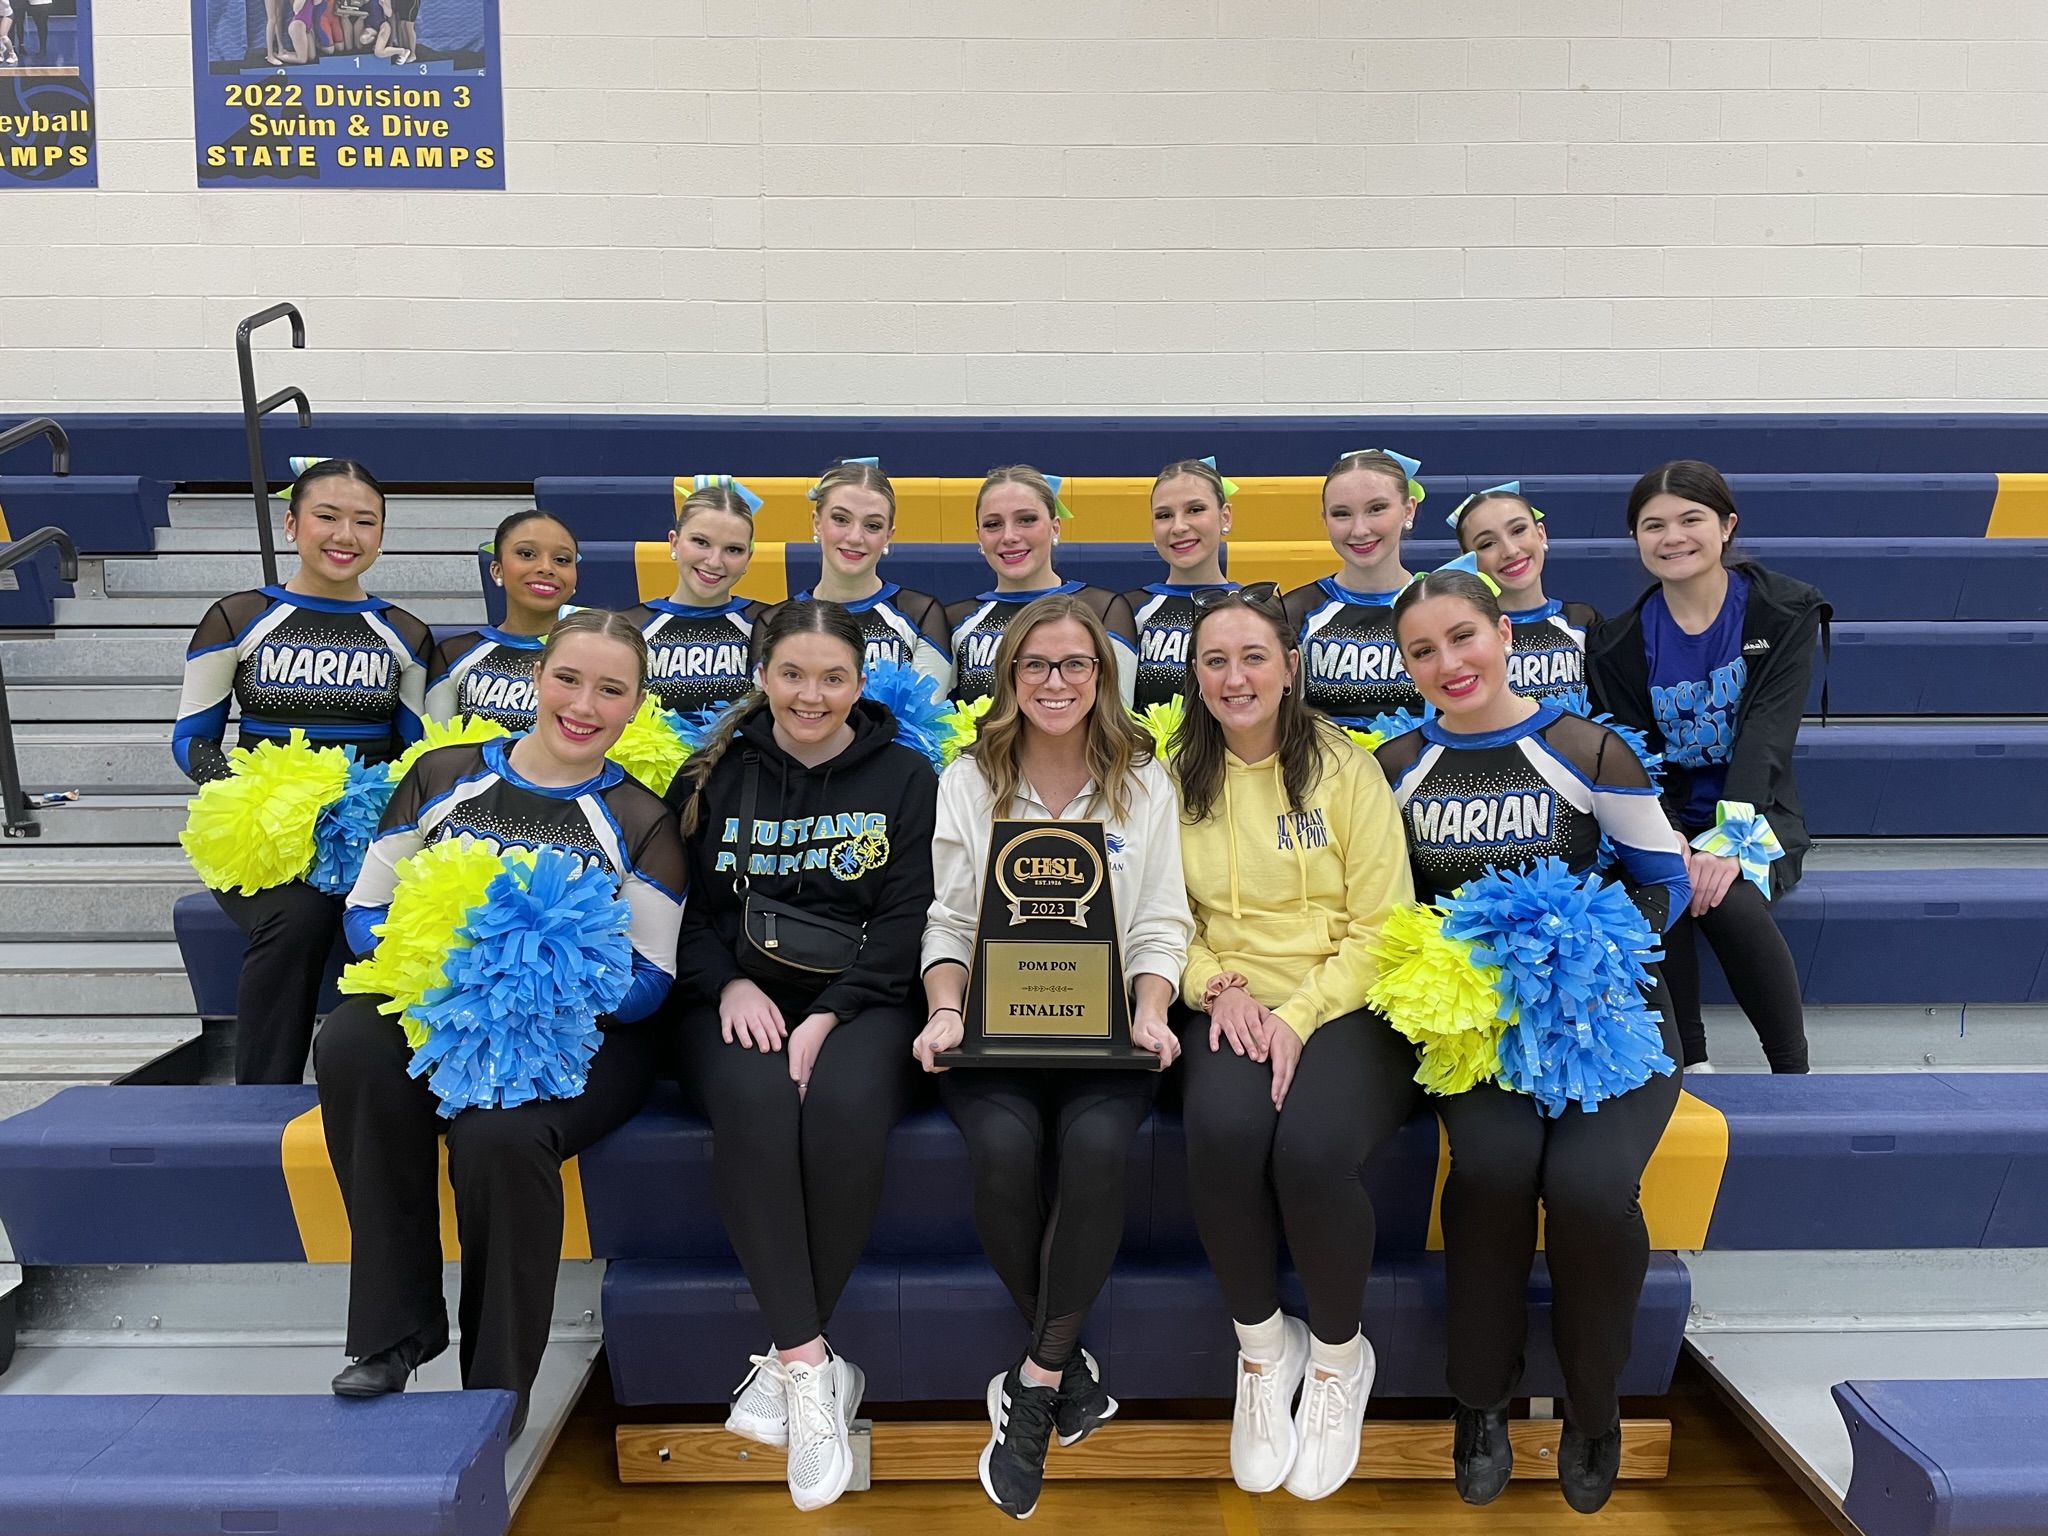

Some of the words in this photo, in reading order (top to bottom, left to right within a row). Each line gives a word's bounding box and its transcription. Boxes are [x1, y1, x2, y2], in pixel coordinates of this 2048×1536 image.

[353, 57, 360, 69] 1
[419, 64, 428, 75] 3
[225, 84, 302, 106] 2022
[315, 84, 440, 107] Division
[453, 85, 471, 108] 3
[0, 109, 88, 137] eyball
[249, 114, 336, 136] Swim
[347, 114, 370, 137] &
[382, 114, 449, 137] Dive
[0, 145, 88, 167] MPS
[207, 145, 316, 167] STATE
[337, 146, 495, 169] CHAMPS
[260, 645, 391, 688] MARIAN
[647, 644, 749, 680] MARIAN
[1413, 792, 1550, 845] MARIAN
[714, 848, 829, 876] PMPON
[1013, 857, 1084, 880] CHSL
[1031, 902, 1065, 915] 2023
[1018, 961, 1048, 971] POM
[1050, 961, 1077, 971] PON
[1009, 1004, 1085, 1017] FINALIST
